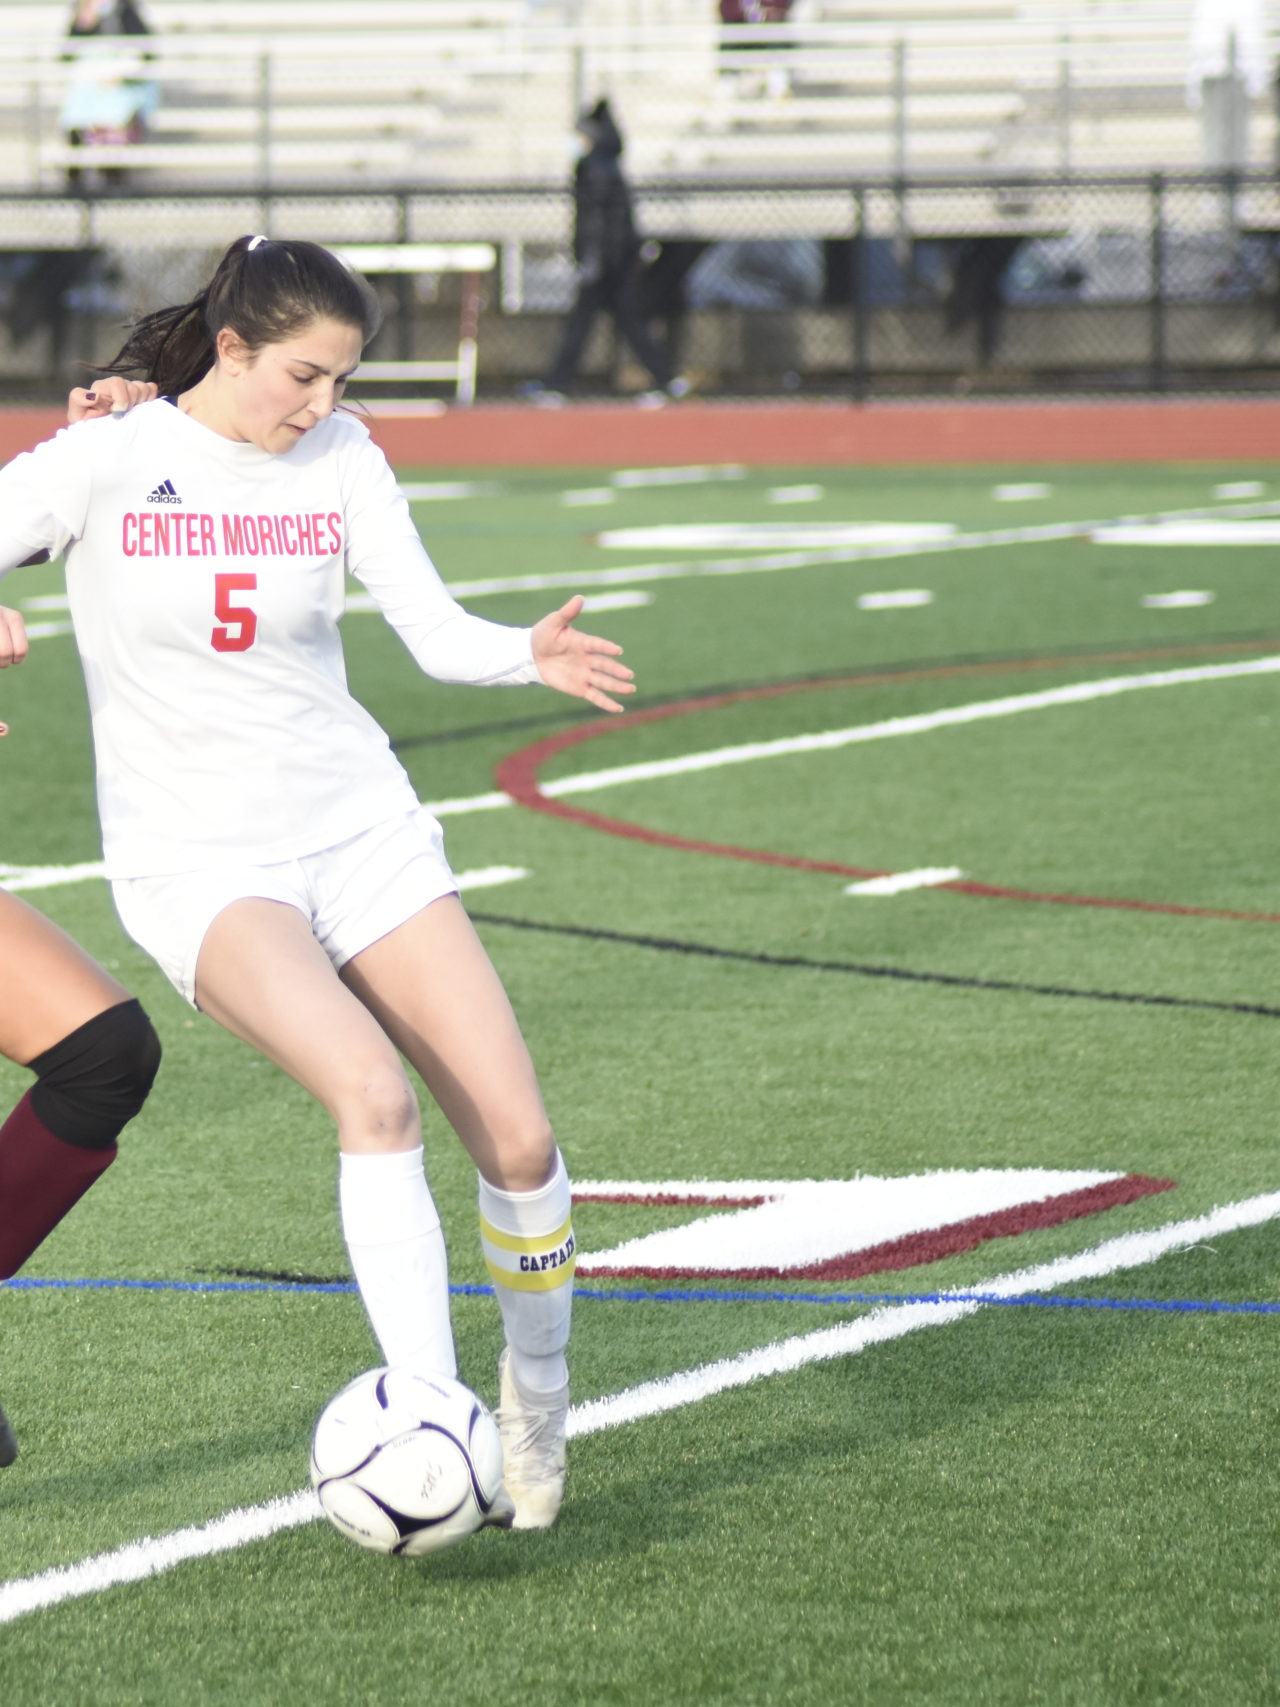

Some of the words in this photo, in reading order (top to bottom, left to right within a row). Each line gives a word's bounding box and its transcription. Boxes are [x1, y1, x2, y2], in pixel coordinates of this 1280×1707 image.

[146, 490, 183, 505] adidas
[122, 512, 217, 557] CENTER
[222, 511, 342, 556] MORICHES
[210, 573, 258, 653] 5
